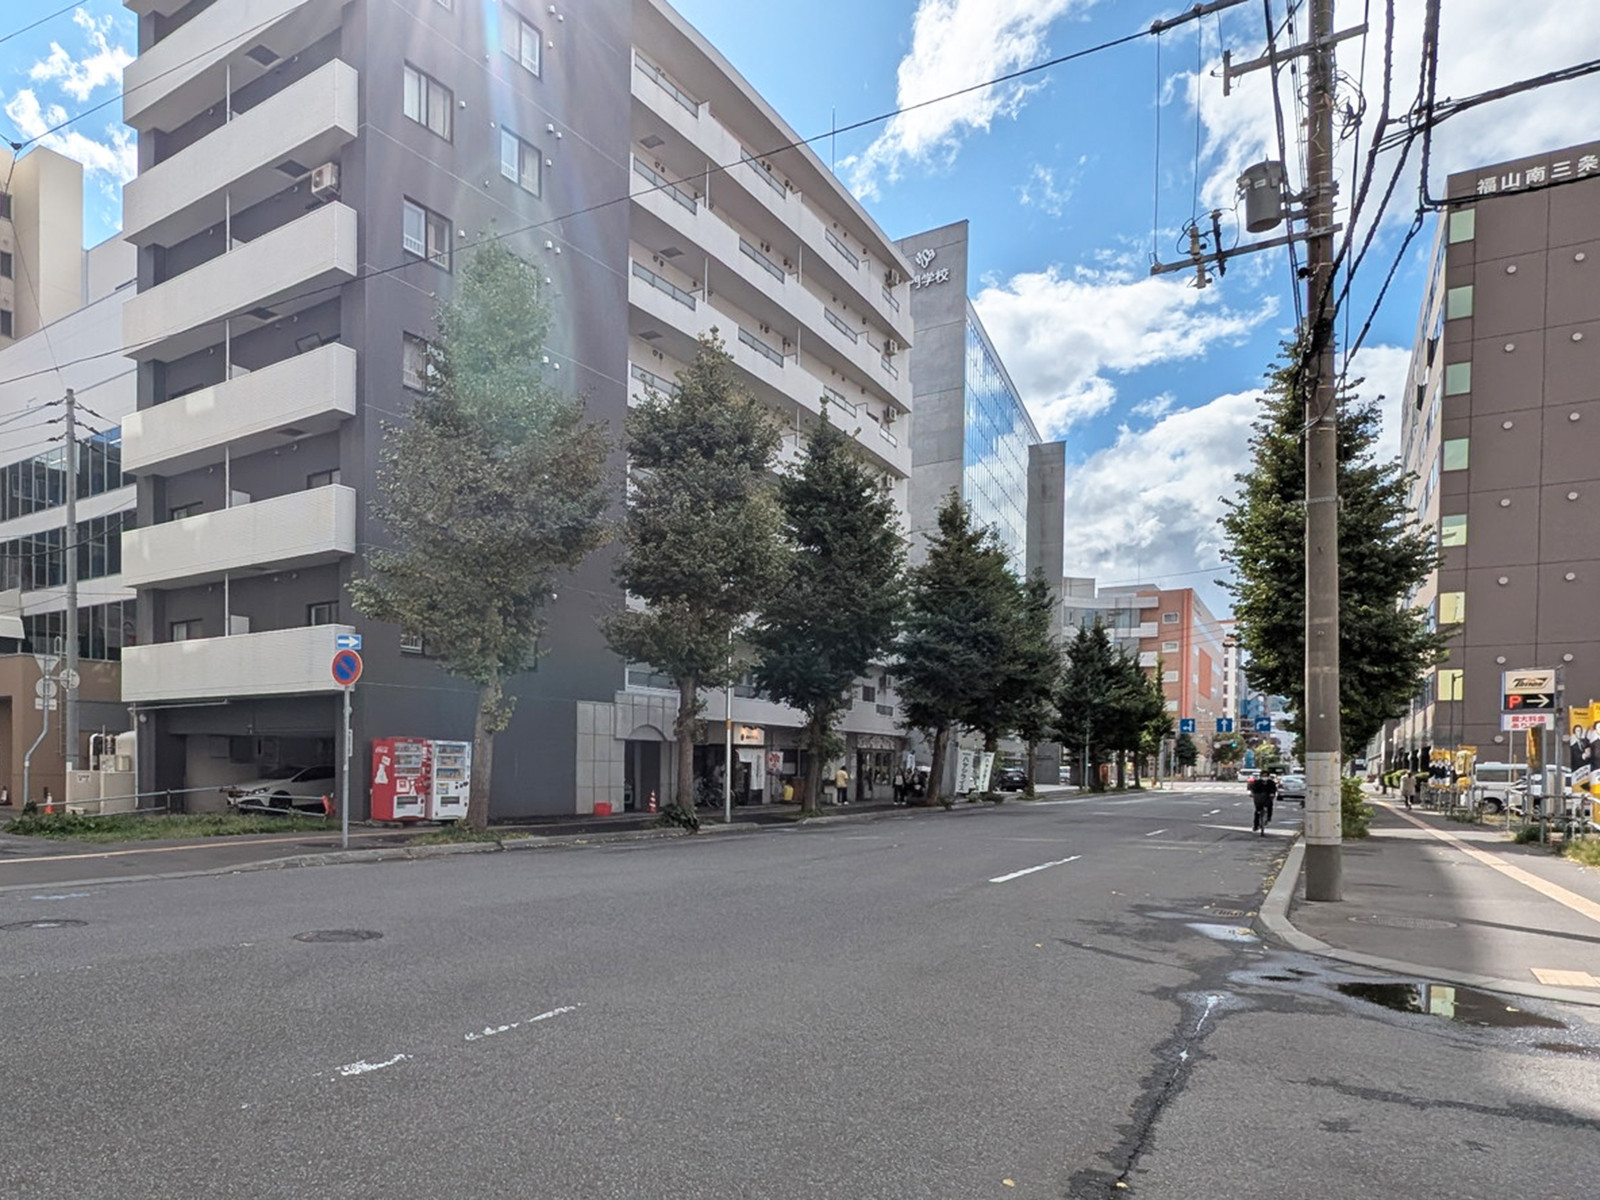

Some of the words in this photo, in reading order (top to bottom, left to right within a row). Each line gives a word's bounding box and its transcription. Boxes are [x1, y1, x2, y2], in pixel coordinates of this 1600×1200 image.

[1476, 154, 1599, 195] 福山南三条
[1508, 695, 1522, 709] P
